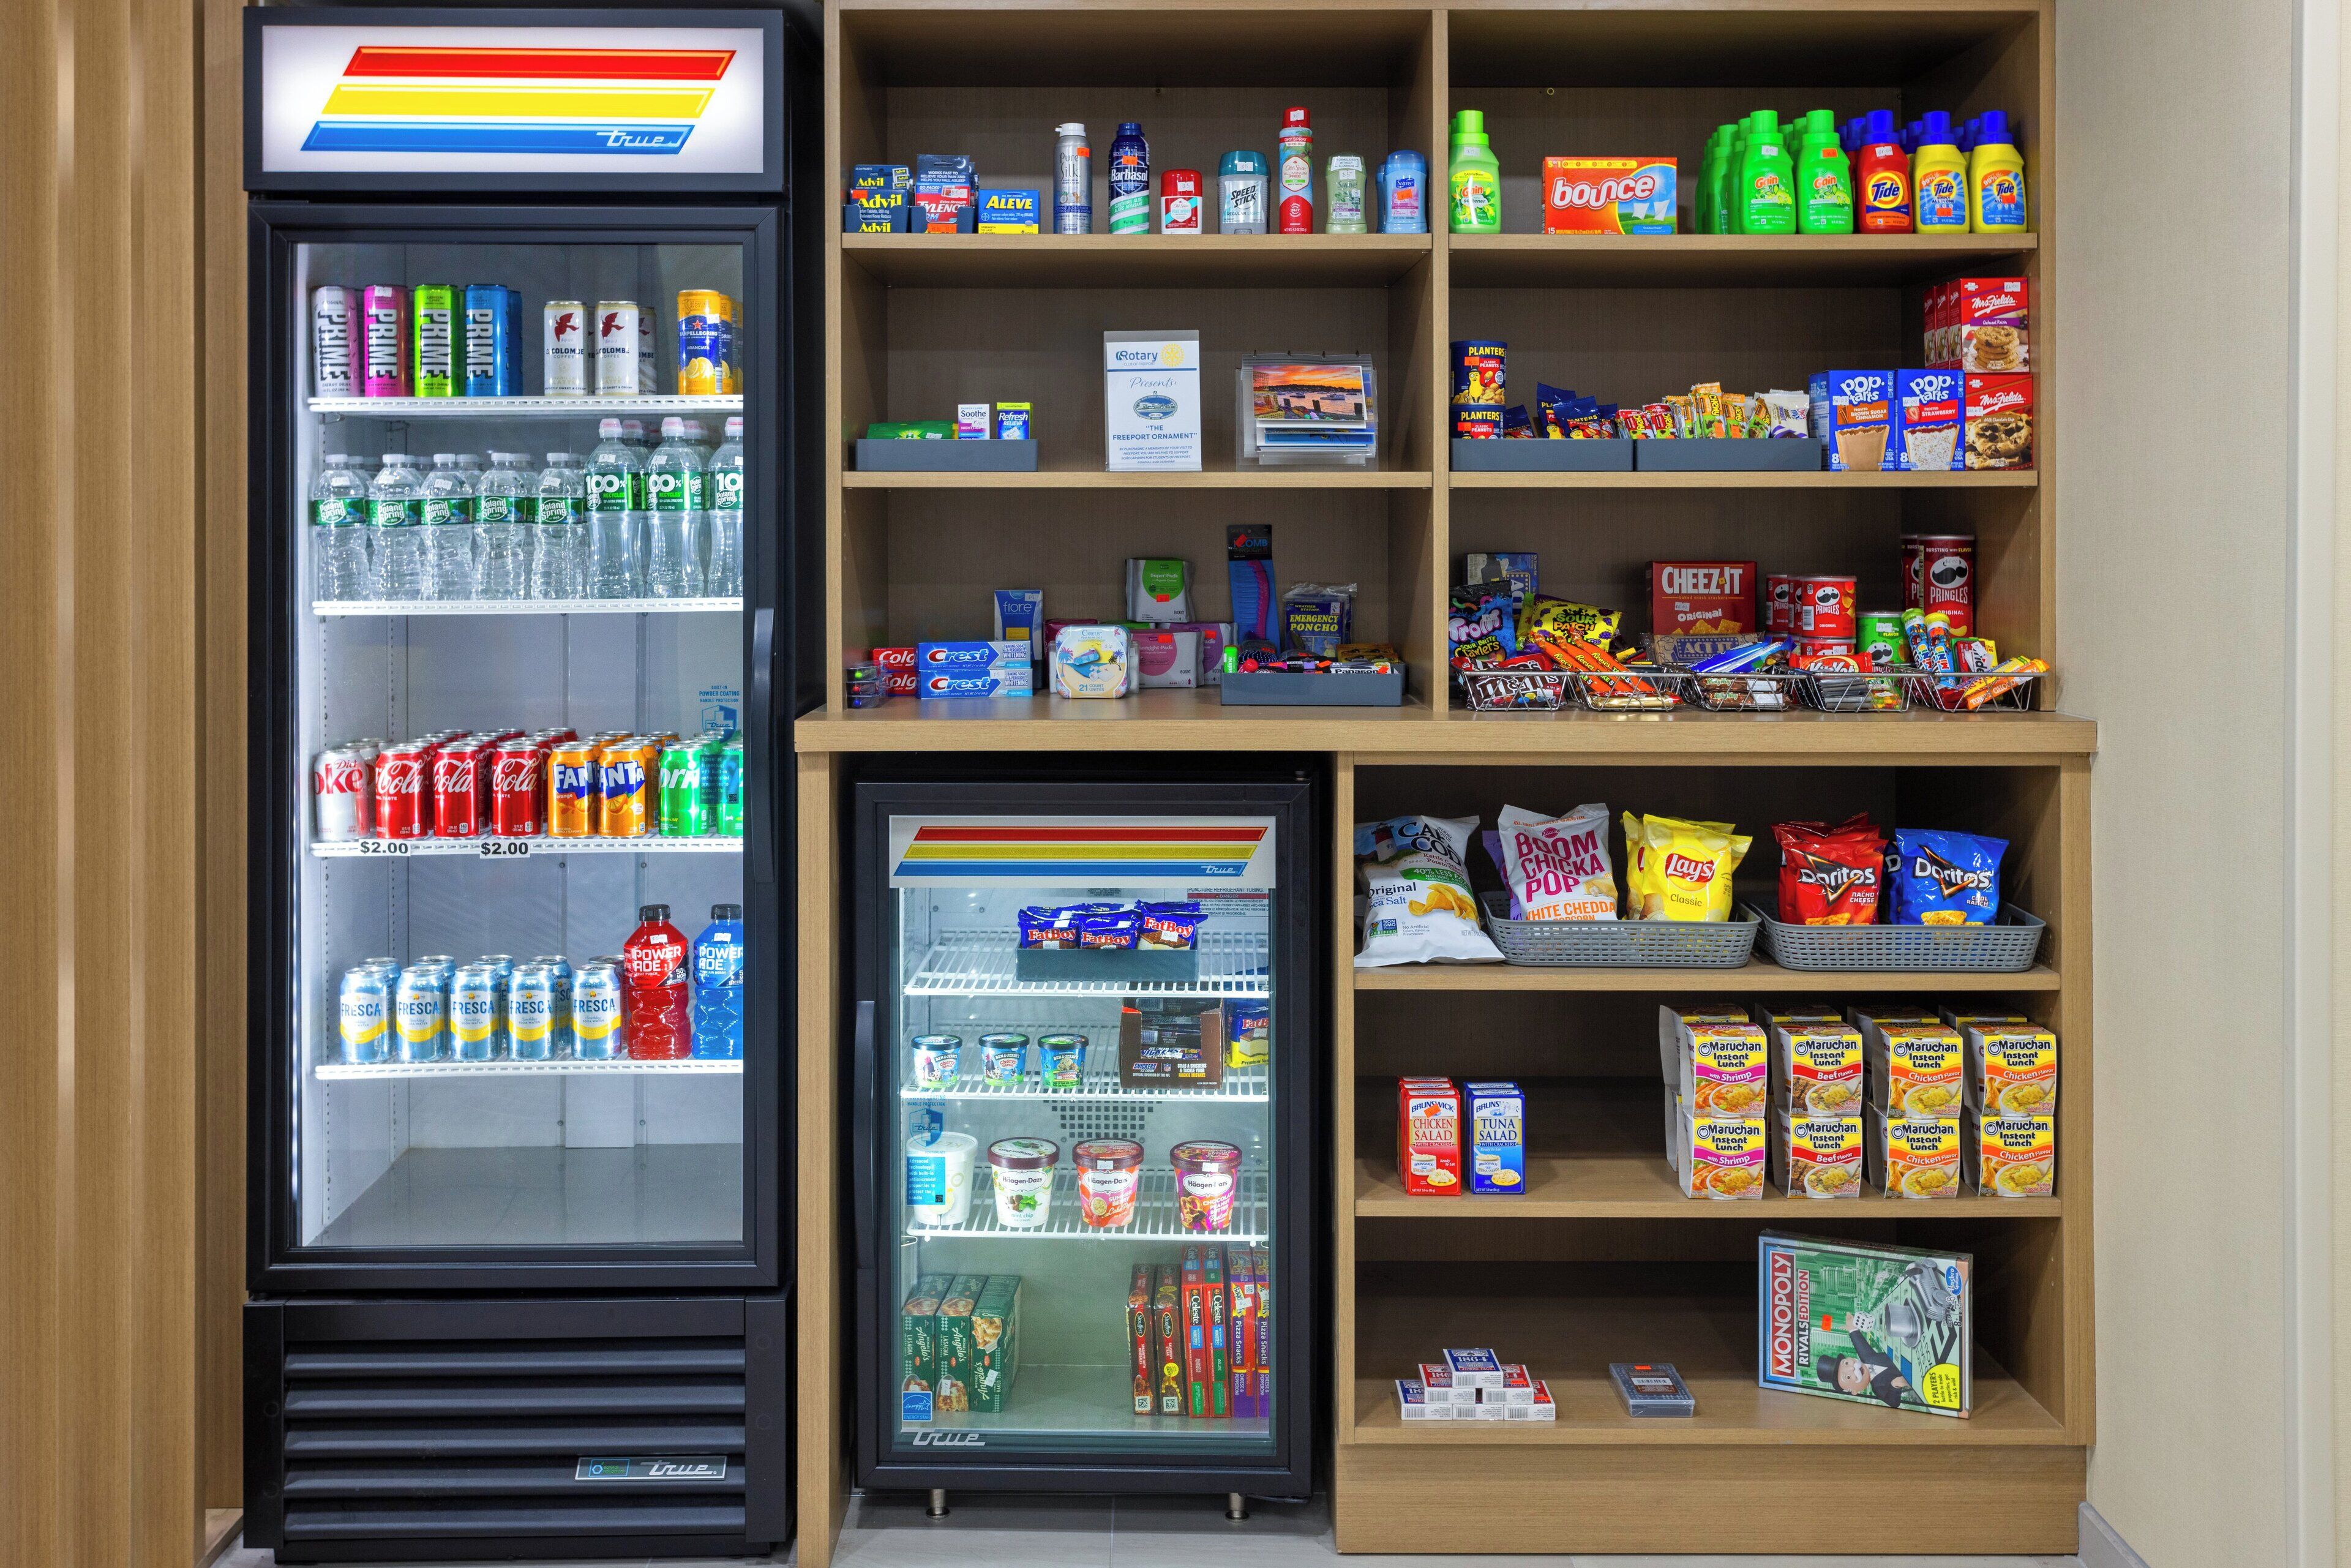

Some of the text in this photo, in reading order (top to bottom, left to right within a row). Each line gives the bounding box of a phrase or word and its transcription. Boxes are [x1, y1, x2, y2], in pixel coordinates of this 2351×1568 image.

[1060, 152, 1078, 163] Pure
[1111, 169, 1149, 181] Barbasol
[856, 178, 885, 187] Advil
[1755, 176, 1779, 189] Gain
[1813, 176, 1837, 189] Gain
[1934, 182, 1954, 196] Tide
[1996, 182, 2014, 196] Tide
[1231, 185, 1256, 200] SPEED
[1553, 176, 1656, 209] bounce
[1872, 182, 1900, 202] Tide
[986, 195, 1033, 210] ALEVE
[1234, 192, 1256, 208] STICK
[858, 222, 892, 233] Advil
[368, 309, 397, 379] PRIME
[421, 309, 452, 379] PRIME
[467, 309, 493, 379] PRIME
[1120, 351, 1158, 361] Rotary
[1469, 347, 1504, 356] PLANTERS
[1130, 377, 1177, 388] Presents:
[999, 411, 1029, 421] Refresh
[1461, 411, 1499, 421] PLANTERS
[586, 475, 626, 492] 100%
[320, 500, 343, 511] Poland
[1930, 587, 1968, 604] PRINGLES
[1003, 602, 1032, 612] fiore
[1816, 604, 1840, 615] PRINGLES
[1289, 614, 1339, 623] EMERGENCY
[1556, 613, 1595, 625] SOUR
[1553, 621, 1595, 631] PATCH
[928, 649, 988, 663] Crest
[931, 677, 991, 691] Crest
[334, 759, 357, 770] Diet
[360, 841, 409, 854] $2.00
[481, 842, 529, 855] $2.00
[1514, 830, 1599, 860] BOOM
[1520, 853, 1605, 880] CHICKA
[1667, 853, 1715, 882] Lay's
[1915, 857, 1992, 888] Doritos
[1799, 867, 1876, 886] Doritos
[1367, 882, 1417, 899] Original
[1526, 870, 1581, 903] POP
[1670, 893, 1703, 907] Classic
[1144, 917, 1193, 937] FatBoy
[1028, 928, 1076, 941] FatBoy
[1081, 932, 1131, 945] FatBoy
[633, 946, 681, 961] POWER
[634, 960, 662, 972] ADE
[342, 1003, 381, 1018] FRESCA
[398, 1001, 440, 1015] FRESCA
[452, 1000, 495, 1015] FRESCA
[573, 999, 615, 1013] FRESCA
[1709, 1041, 1762, 1052] Maruchan
[1805, 1040, 1858, 1051] Maruchan
[1999, 1040, 2050, 1051] Maruchan
[2003, 1051, 2038, 1059] Instant
[1721, 1071, 1752, 1083] Shrimp
[1817, 1068, 1853, 1081] Beef Flavor
[2003, 1067, 2054, 1081] Chicken Flavor
[1413, 1118, 1453, 1128] CHICKEN
[1480, 1118, 1516, 1128] TUNA
[1995, 1120, 2048, 1131] Maruchan
[1414, 1130, 1453, 1141] SALAD
[1479, 1130, 1517, 1141] SALAD
[2000, 1149, 2052, 1161] Chicken Flavor
[1002, 1175, 1043, 1185] Häagen-Dazs
[1213, 1294, 1221, 1324] Celeste
[1774, 1255, 1792, 1375] MONOPOLY
[1798, 1270, 1810, 1365] RIVALS EDITION
[1932, 1371, 1940, 1399] PLAYERS
[640, 1460, 717, 1475] true
